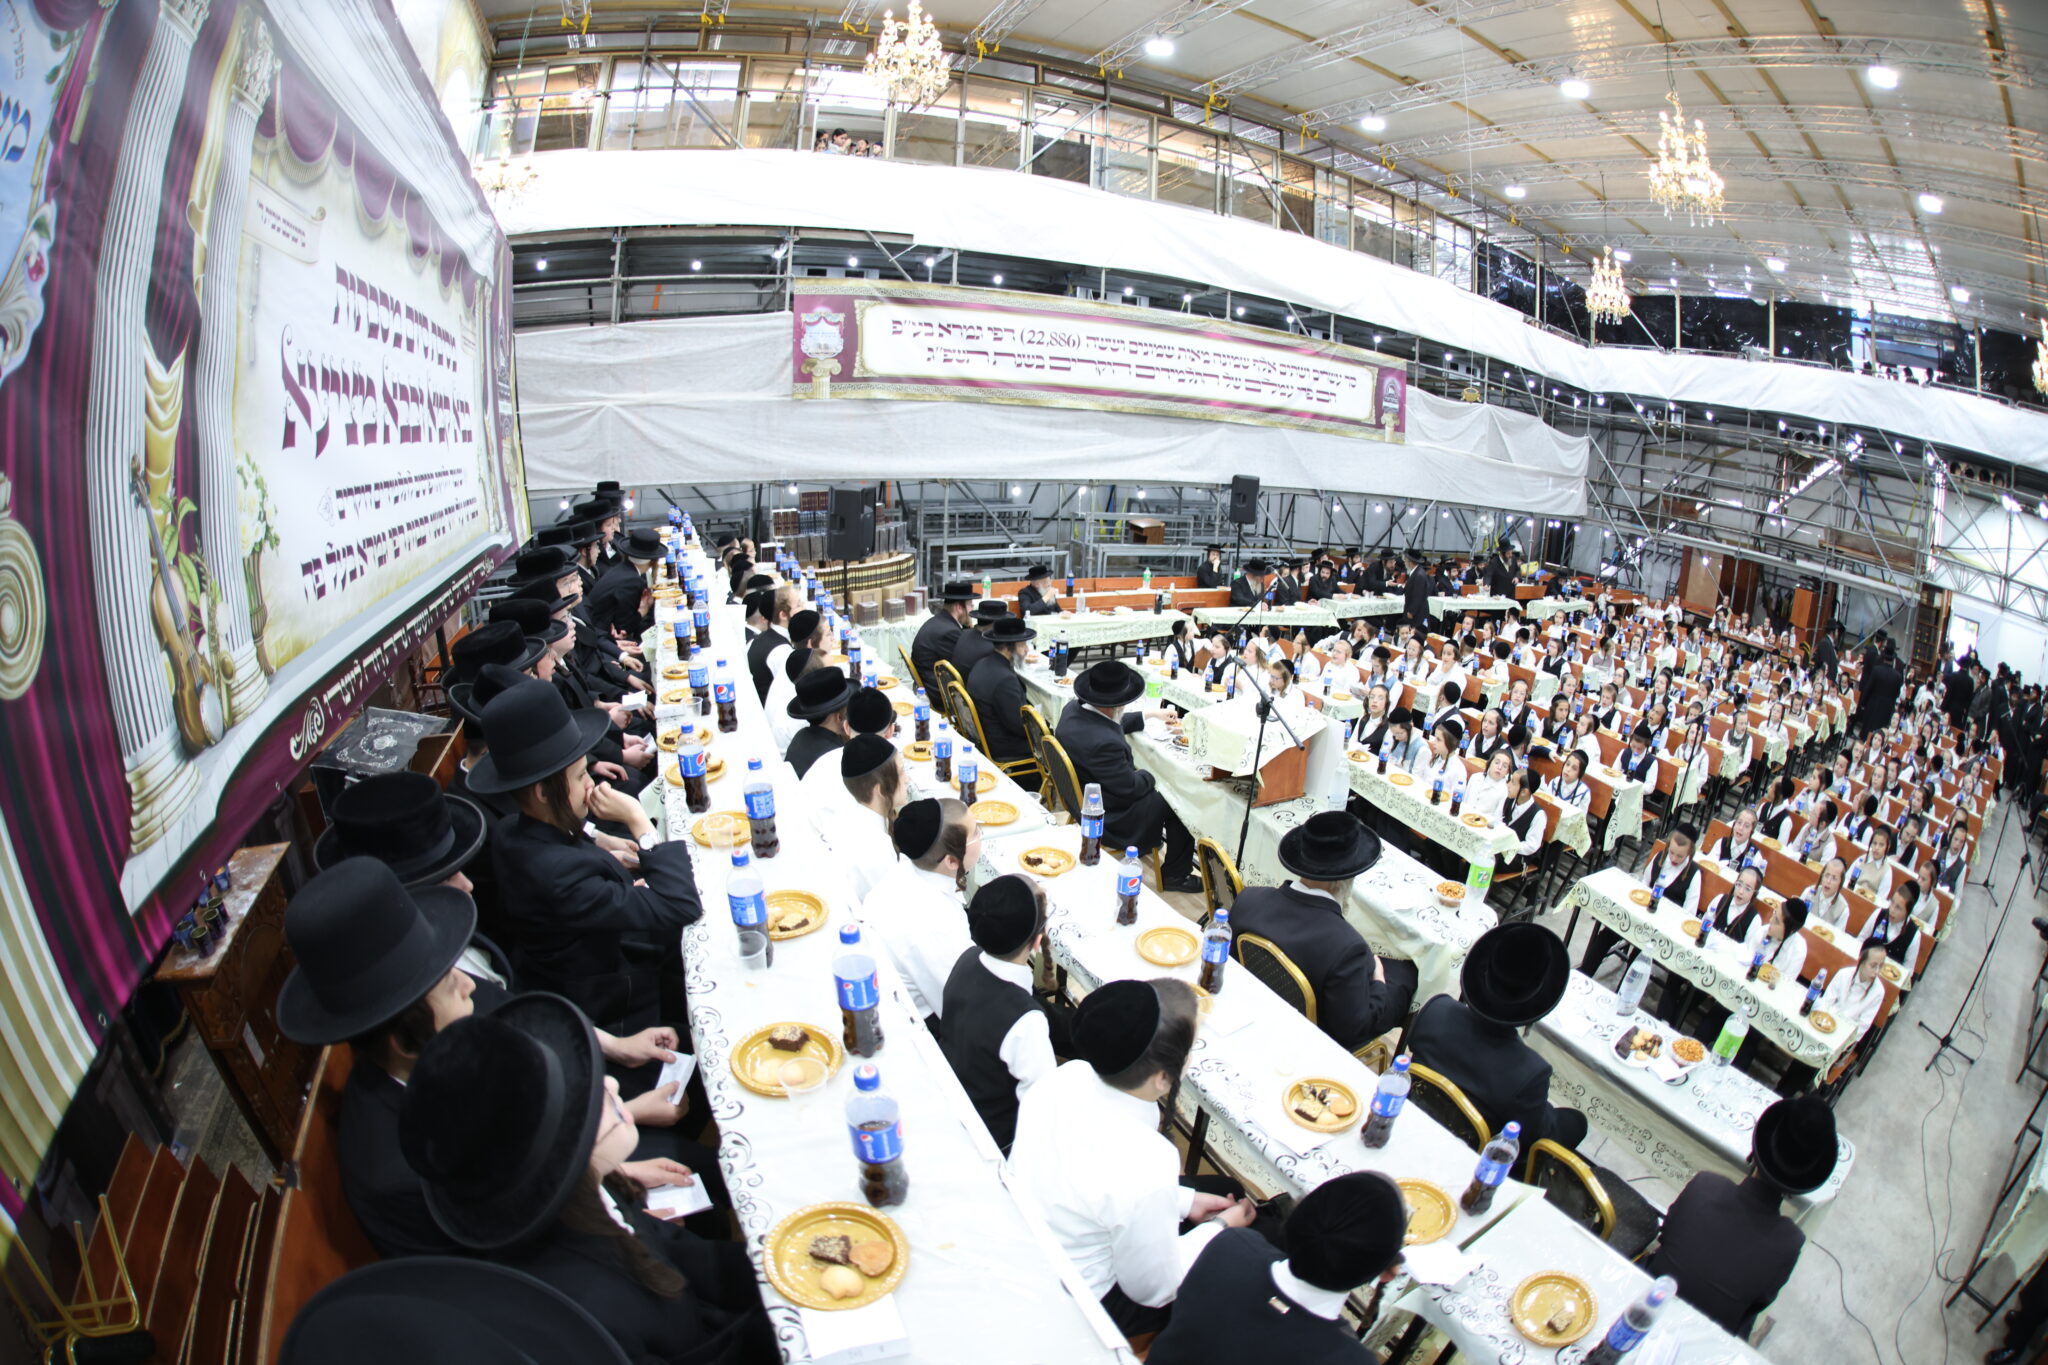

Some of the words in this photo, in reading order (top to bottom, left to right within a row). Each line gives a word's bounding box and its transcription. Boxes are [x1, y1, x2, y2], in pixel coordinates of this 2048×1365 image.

[333, 261, 402, 350] מסכתות
[405, 303, 430, 361] סיום
[938, 322, 983, 340] גמרא
[987, 326, 1015, 342] דפי
[1020, 328, 1081, 350] (22,886)
[431, 319, 457, 373] מסיבת
[1086, 335, 1125, 351] וששה
[1129, 340, 1175, 359] שמונים
[993, 351, 1045, 369] בשנת
[1049, 355, 1132, 376] היקרים
[1178, 346, 1210, 364] מאות
[1213, 352, 1249, 369] שמונה
[1253, 357, 1277, 373] אלף
[1135, 364, 1220, 385] התלמידים
[1222, 372, 1241, 389] של
[1280, 363, 1310, 379] ושתים
[1313, 369, 1342, 386] עשרים
[1344, 375, 1357, 388] סך
[281, 323, 379, 460] מציעא
[382, 354, 426, 445] ובבא
[1297, 386, 1313, 401] פרי
[1316, 389, 1336, 403] הם
[426, 370, 451, 450] קמא
[452, 382, 473, 444] בבא
[335, 484, 372, 520] היקרים
[388, 524, 405, 559] דפי
[356, 531, 389, 578] גמרא
[325, 542, 358, 592] בעל
[300, 557, 326, 604] פה
